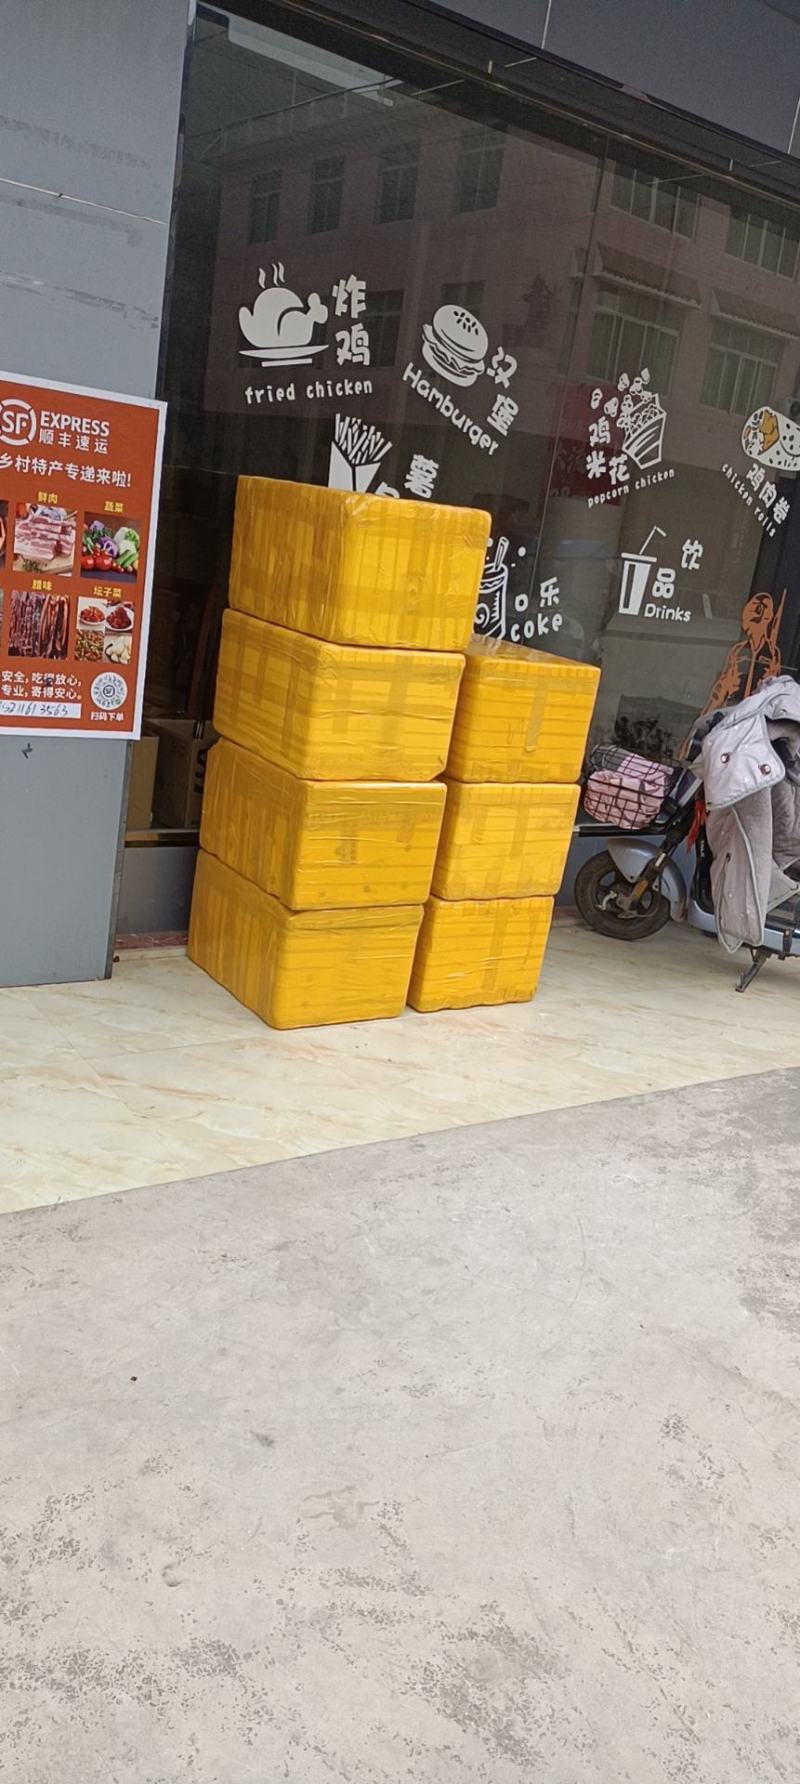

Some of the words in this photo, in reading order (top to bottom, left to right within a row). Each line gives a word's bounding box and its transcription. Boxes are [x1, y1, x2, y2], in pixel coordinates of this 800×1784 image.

[332, 274, 370, 366] 炸鸡
[244, 382, 296, 405] fried
[306, 378, 373, 400] chicken
[486, 346, 519, 436] 汉堡
[1, 411, 29, 434] SF
[40, 411, 110, 436] EXPRESS
[402, 362, 500, 456] Hamburger
[39, 429, 108, 454] 顺丰速运
[37, 491, 58, 505] 鲜肉
[587, 485, 630, 509] popcorn
[635, 467, 675, 490] chicken
[721, 463, 752, 507] chicken
[753, 507, 776, 538] rolls
[745, 463, 791, 525] 鸡肉卷
[104, 500, 124, 513] 蔬菜
[510, 611, 563, 642] coke
[644, 603, 691, 623] Drinks
[90, 711, 124, 723] 扫码下单
